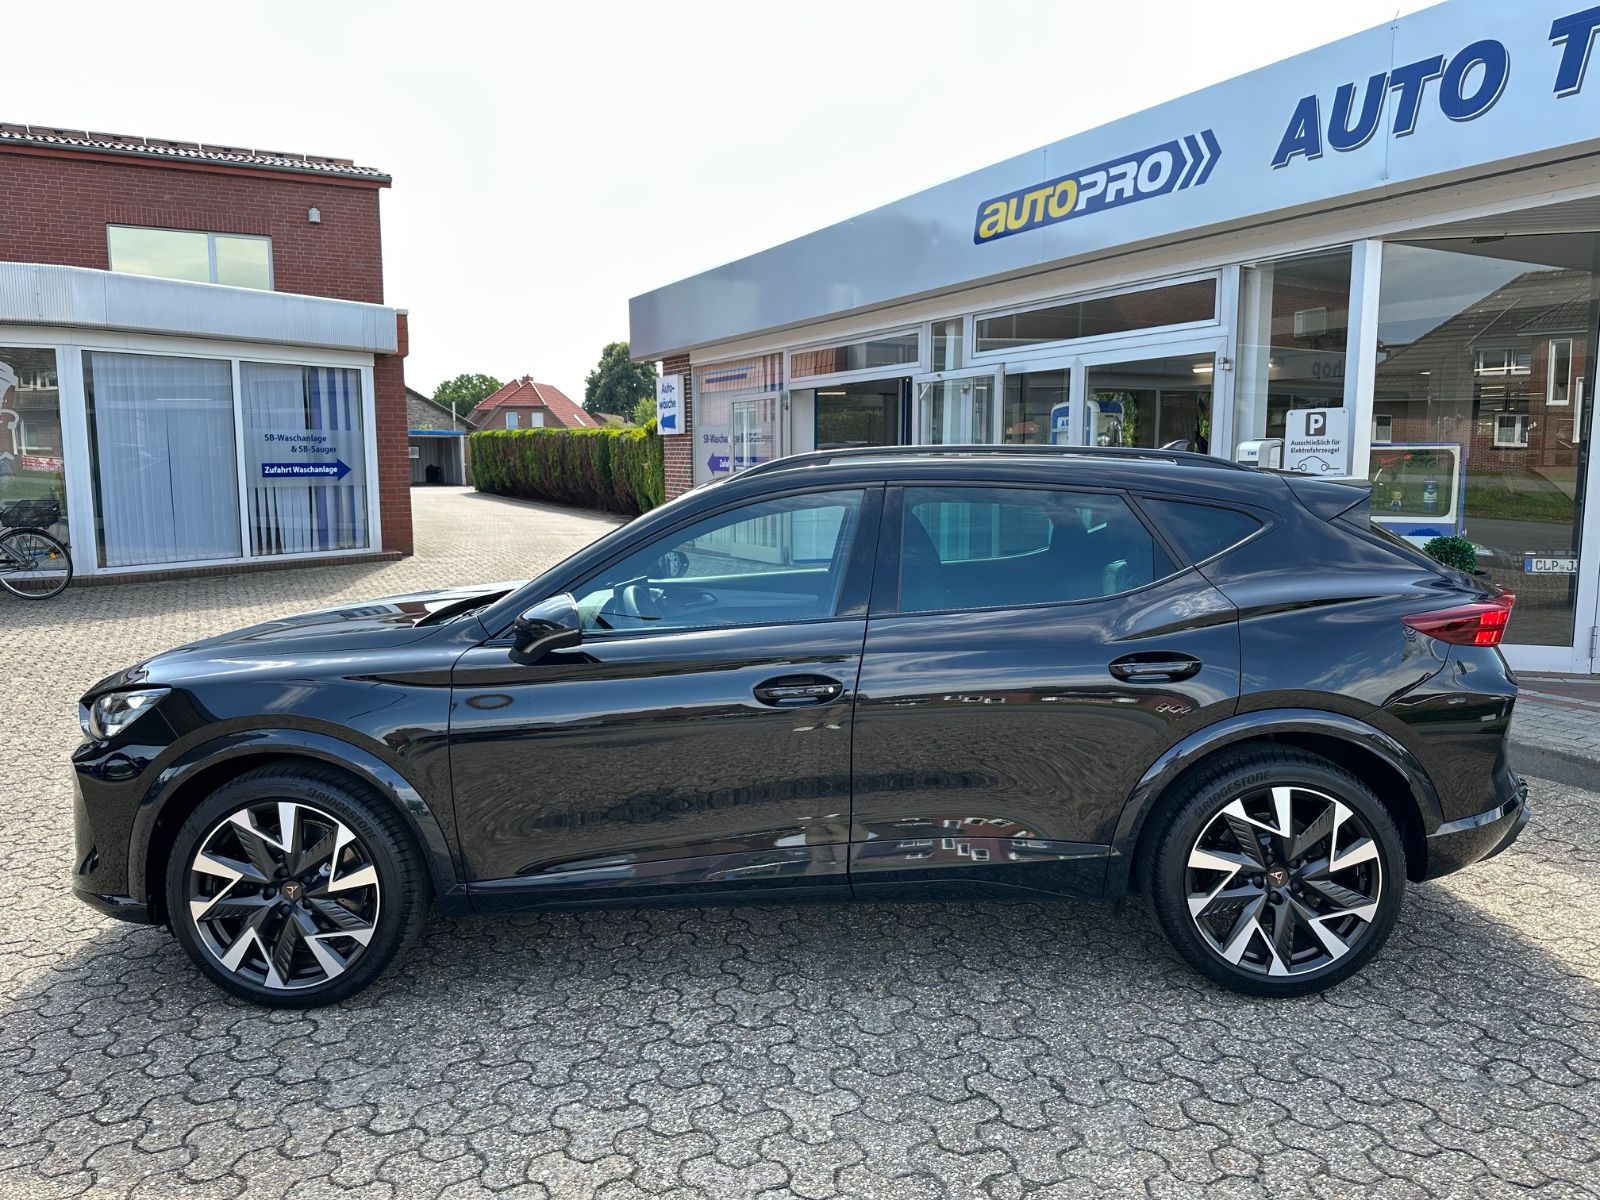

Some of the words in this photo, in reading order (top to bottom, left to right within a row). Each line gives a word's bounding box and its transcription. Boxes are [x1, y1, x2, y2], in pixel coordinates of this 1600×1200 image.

[1271, 39, 1510, 169] AUTO
[661, 383, 675, 393] Auto-
[659, 398, 677, 409] wäsche
[1309, 414, 1324, 435] P
[264, 433, 327, 443] SB-Waschanlage
[298, 446, 337, 454] SB-Sauger
[264, 466, 292, 474] Zufahrt
[292, 465, 338, 475] Waschanlage
[1535, 560, 1559, 571] CLP
[1195, 770, 1271, 818] BRIDGESTONE
[306, 787, 378, 841] BRIDGESTONE
